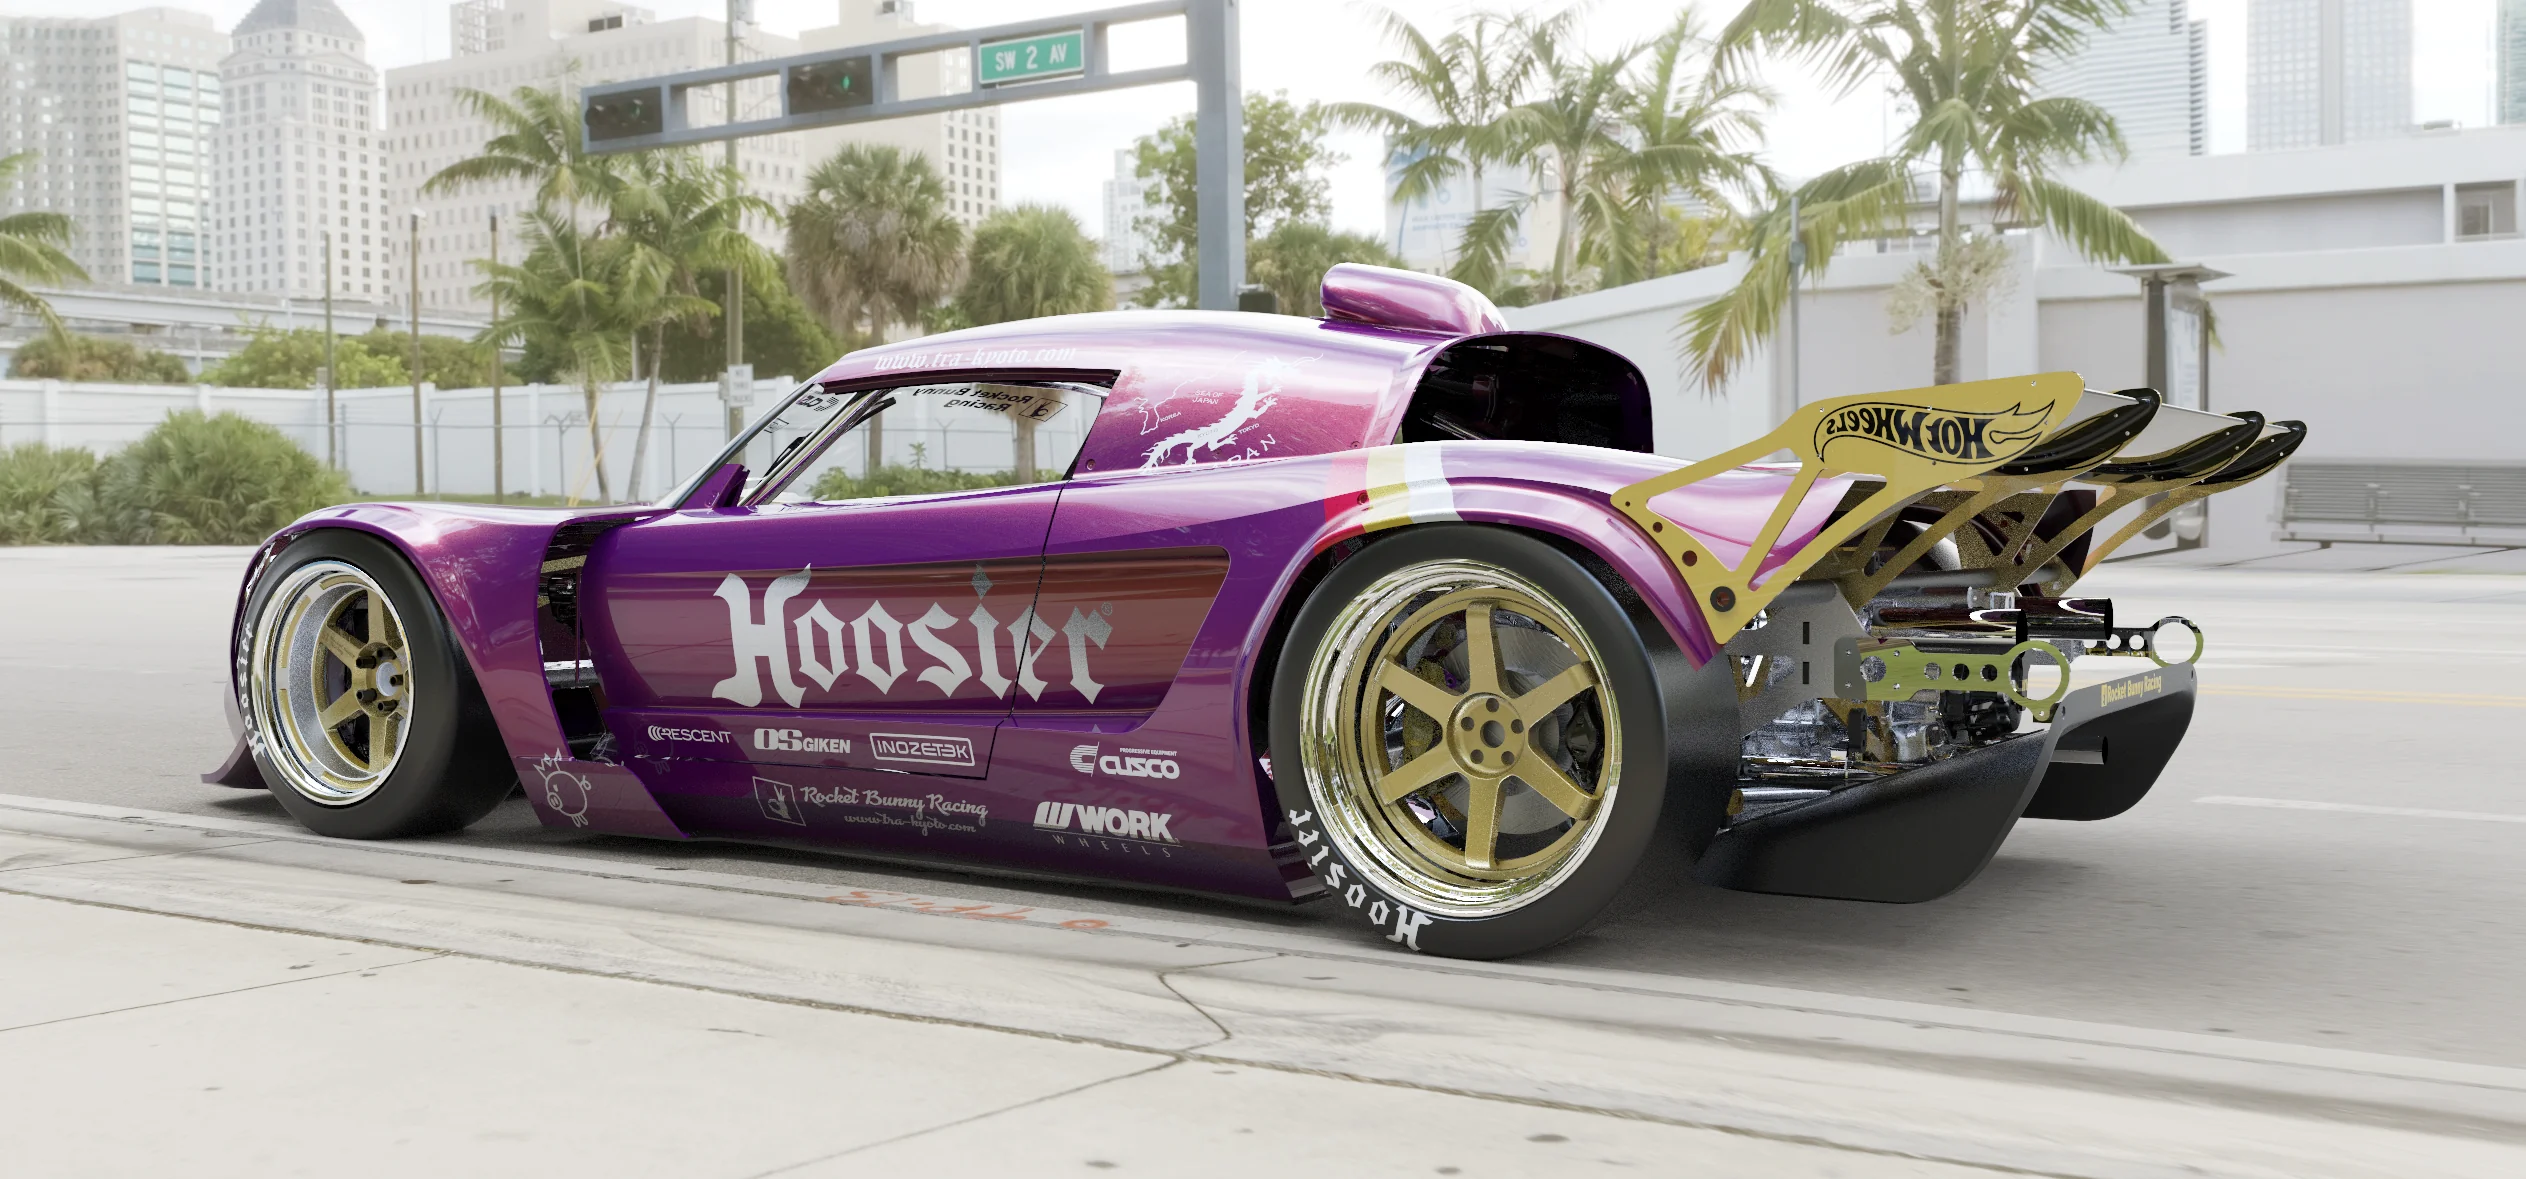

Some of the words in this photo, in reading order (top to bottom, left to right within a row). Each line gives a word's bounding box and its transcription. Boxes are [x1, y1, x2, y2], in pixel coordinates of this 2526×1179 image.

[995, 50, 1016, 71] SW
[1026, 45, 1038, 69] 2
[1049, 42, 1067, 64] AV
[874, 347, 1077, 370] www.tra-kyoto.com
[1192, 397, 1219, 405] JAPAN
[1195, 389, 1211, 398] SEA
[1160, 411, 1182, 422] KOREA
[1197, 427, 1219, 439] KYOTO
[1238, 423, 1260, 435] TOKYO
[712, 563, 1113, 709] Hoosier
[2107, 681, 2126, 703] Rocket
[2127, 680, 2143, 698] Bunny
[2144, 672, 2161, 693] Racing
[1100, 755, 1180, 780] CUSCO
[800, 786, 859, 808] Rocket
[862, 789, 925, 819] Bunny
[925, 793, 988, 827] Racing
[1075, 804, 1176, 844] WORK
[1052, 834, 1171, 858] WHEELS
[1289, 809, 1434, 952] Hoosier
